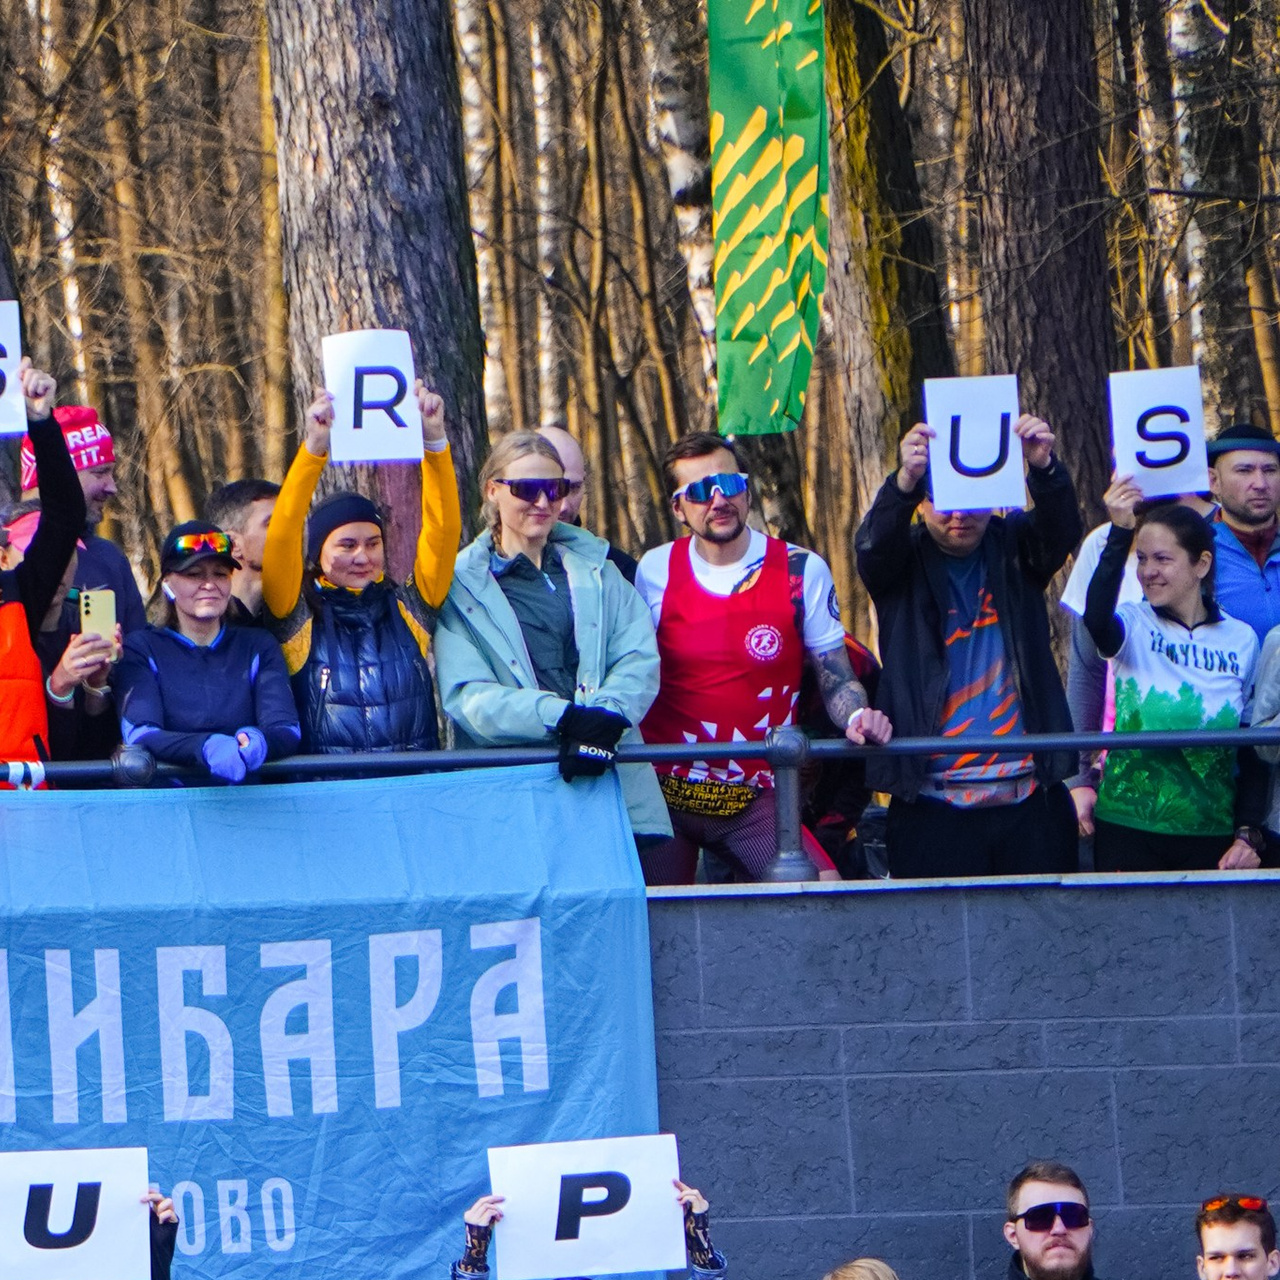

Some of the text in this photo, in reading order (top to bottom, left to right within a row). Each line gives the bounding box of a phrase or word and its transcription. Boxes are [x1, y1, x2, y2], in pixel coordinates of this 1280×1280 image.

[353, 365, 407, 429] R
[949, 412, 1011, 479] U
[1136, 404, 1190, 469] S
[579, 745, 615, 760] SONY
[22, 1181, 102, 1250] U
[172, 1177, 296, 1256] ОВО
[555, 1170, 632, 1241] P
